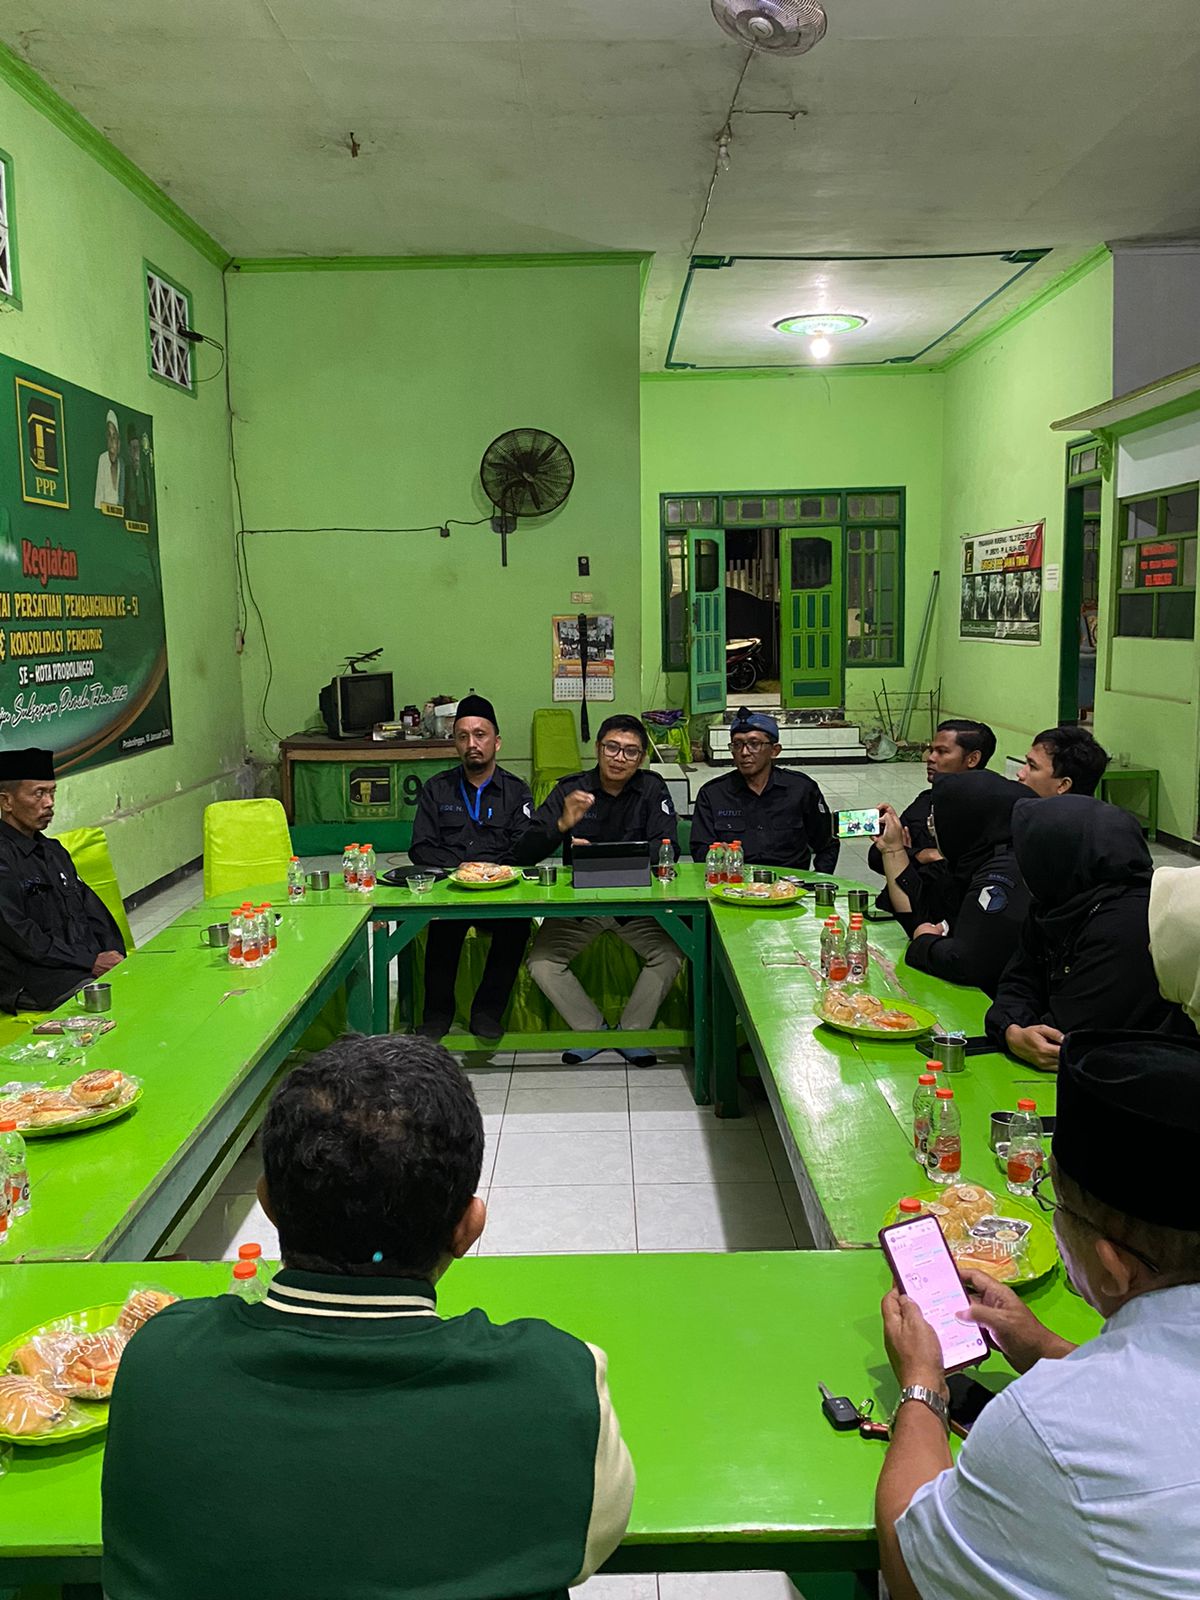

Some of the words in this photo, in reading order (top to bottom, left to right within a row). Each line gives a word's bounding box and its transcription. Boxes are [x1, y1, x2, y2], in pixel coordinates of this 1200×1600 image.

[36, 476, 57, 496] PPP
[22, 540, 77, 585] Kegiatan
[14, 593, 62, 618] PERSATUAN
[64, 594, 116, 618] PEMBANGUNAN
[10, 630, 63, 656] KONSOLIDASI
[66, 628, 103, 652] PENGURUS
[19, 666, 29, 685] SE
[35, 664, 52, 683] KOTA
[53, 660, 94, 680] PROBOLINGGO
[403, 774, 423, 806] 9
